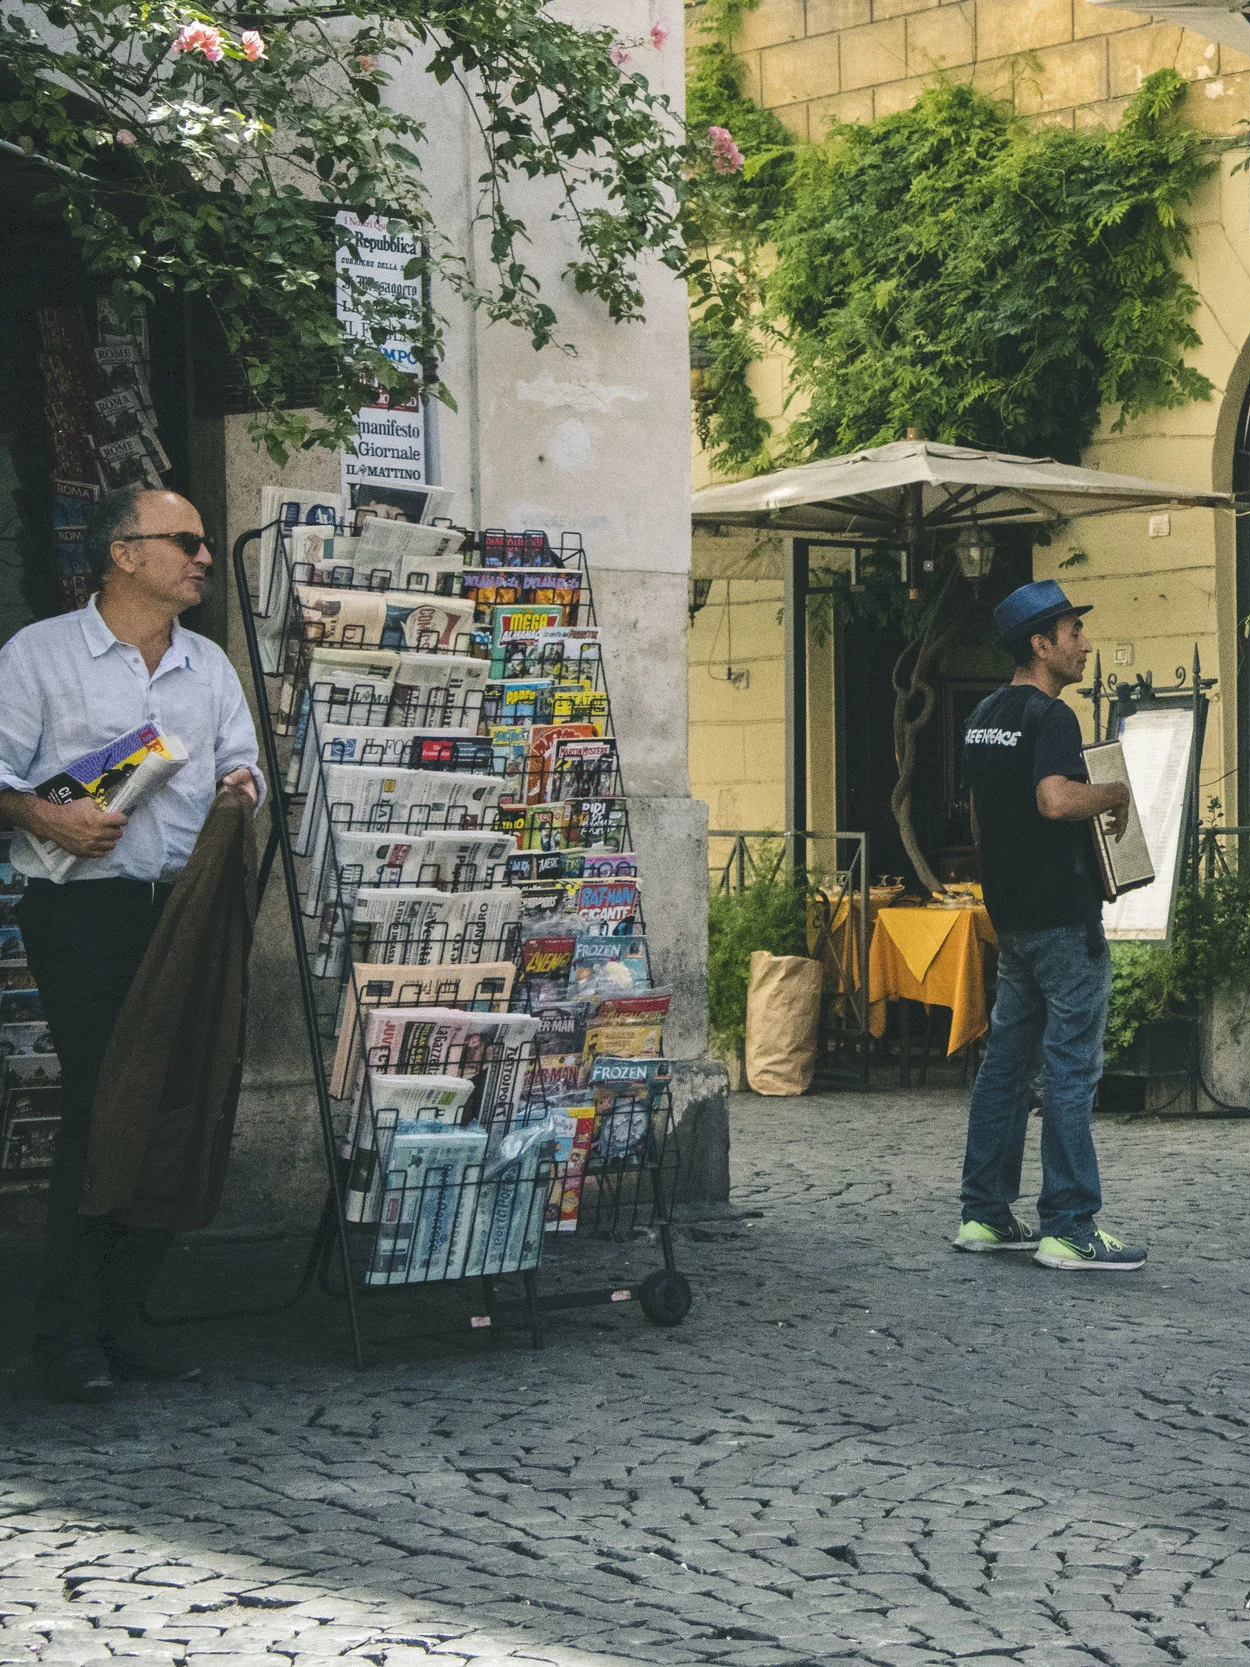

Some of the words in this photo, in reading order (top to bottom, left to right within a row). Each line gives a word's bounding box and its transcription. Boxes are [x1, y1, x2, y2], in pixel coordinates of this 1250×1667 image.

[355, 231, 417, 255] Repubblica
[358, 419, 420, 439] manifesto
[358, 441, 421, 461] Giornale
[346, 464, 358, 475] IL
[367, 466, 421, 481] MATTINO
[57, 483, 90, 498] ROMA
[58, 531, 82, 541] ROM
[510, 613, 549, 632] MEGA
[422, 749, 451, 757] Econoist
[578, 905, 632, 922] GIGANTE
[576, 943, 622, 958] FROZEN
[593, 1065, 647, 1080] FROZEN
